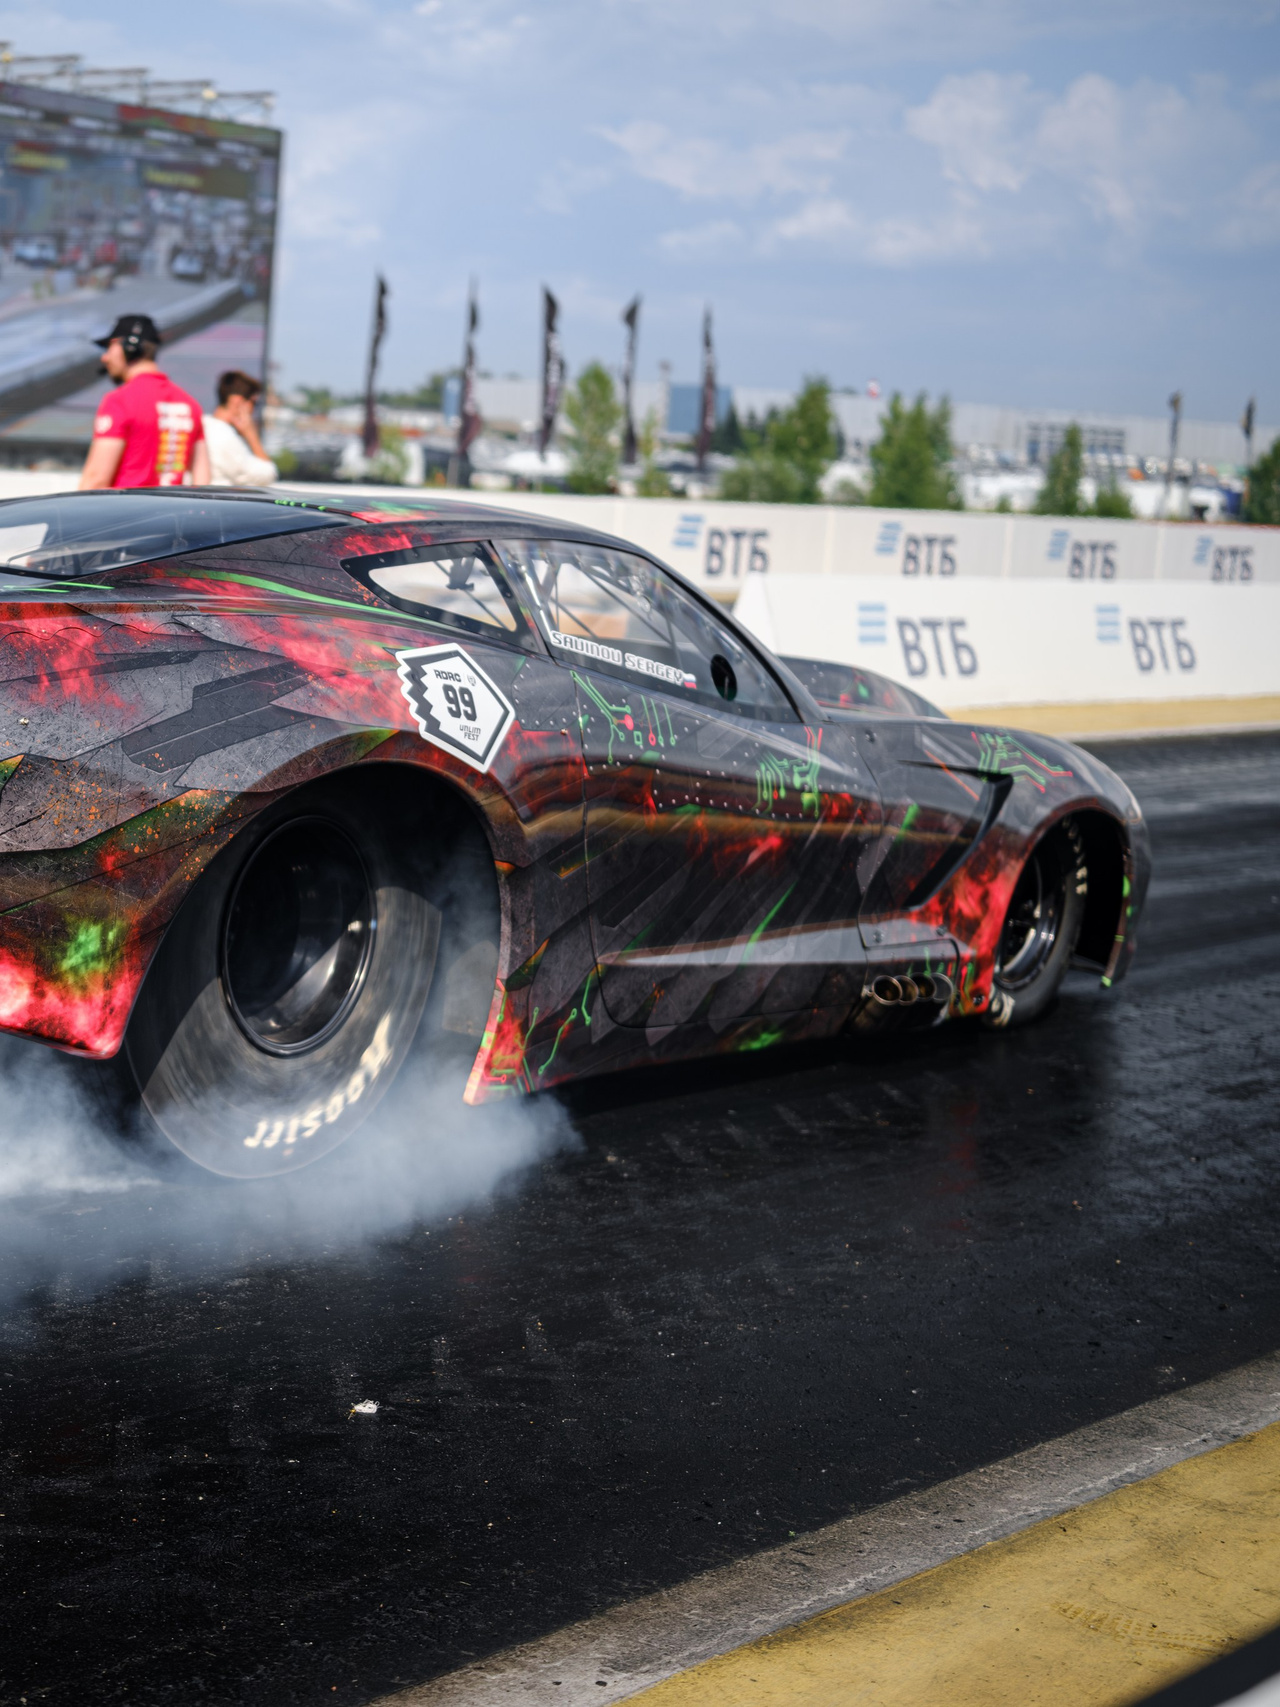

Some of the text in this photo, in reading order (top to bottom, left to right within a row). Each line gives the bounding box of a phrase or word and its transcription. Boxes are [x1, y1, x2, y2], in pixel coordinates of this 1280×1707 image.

[704, 528, 770, 576] ВТБ
[901, 534, 957, 576] ВТБ
[1069, 539, 1117, 580] ВТБ
[896, 617, 978, 677] ВТБ
[1128, 618, 1197, 673] ВТБ
[433, 669, 462, 683] RDRC
[625, 653, 684, 686] SERGEY
[442, 683, 478, 722] 99
[463, 732, 480, 741] FEST
